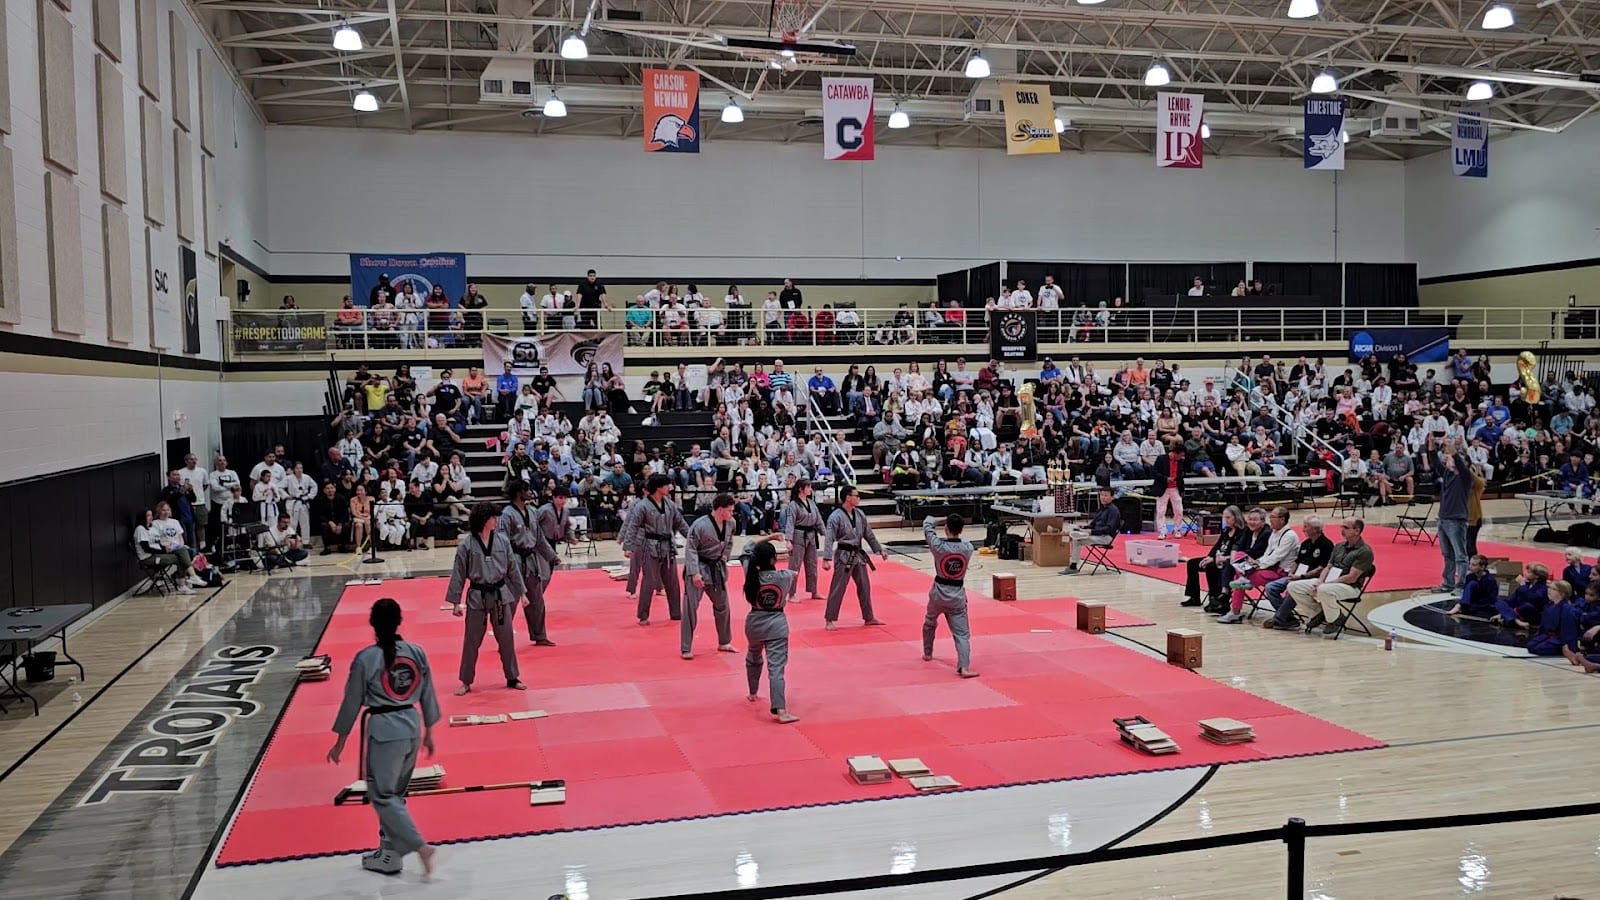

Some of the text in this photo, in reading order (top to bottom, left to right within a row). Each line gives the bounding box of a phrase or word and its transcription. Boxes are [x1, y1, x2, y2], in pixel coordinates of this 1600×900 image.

[653, 73, 688, 91] CARSON-
[654, 91, 688, 108] NEWMAN
[827, 84, 869, 100] CATAWBA
[1016, 90, 1039, 105] COKER
[1168, 96, 1193, 111] LENOIR-
[1307, 99, 1342, 116] LIMESTONE
[1169, 113, 1191, 127] RHYNE
[836, 117, 862, 150] C
[1457, 125, 1483, 140] MEMORIAL
[1163, 131, 1200, 166] LR
[1455, 147, 1487, 169] LMU
[388, 258, 418, 267] Down
[234, 326, 326, 341] #RESPECTOURGAME
[516, 347, 536, 361] 50
[1375, 344, 1398, 352] Division
[77, 645, 279, 807] TROJANS
